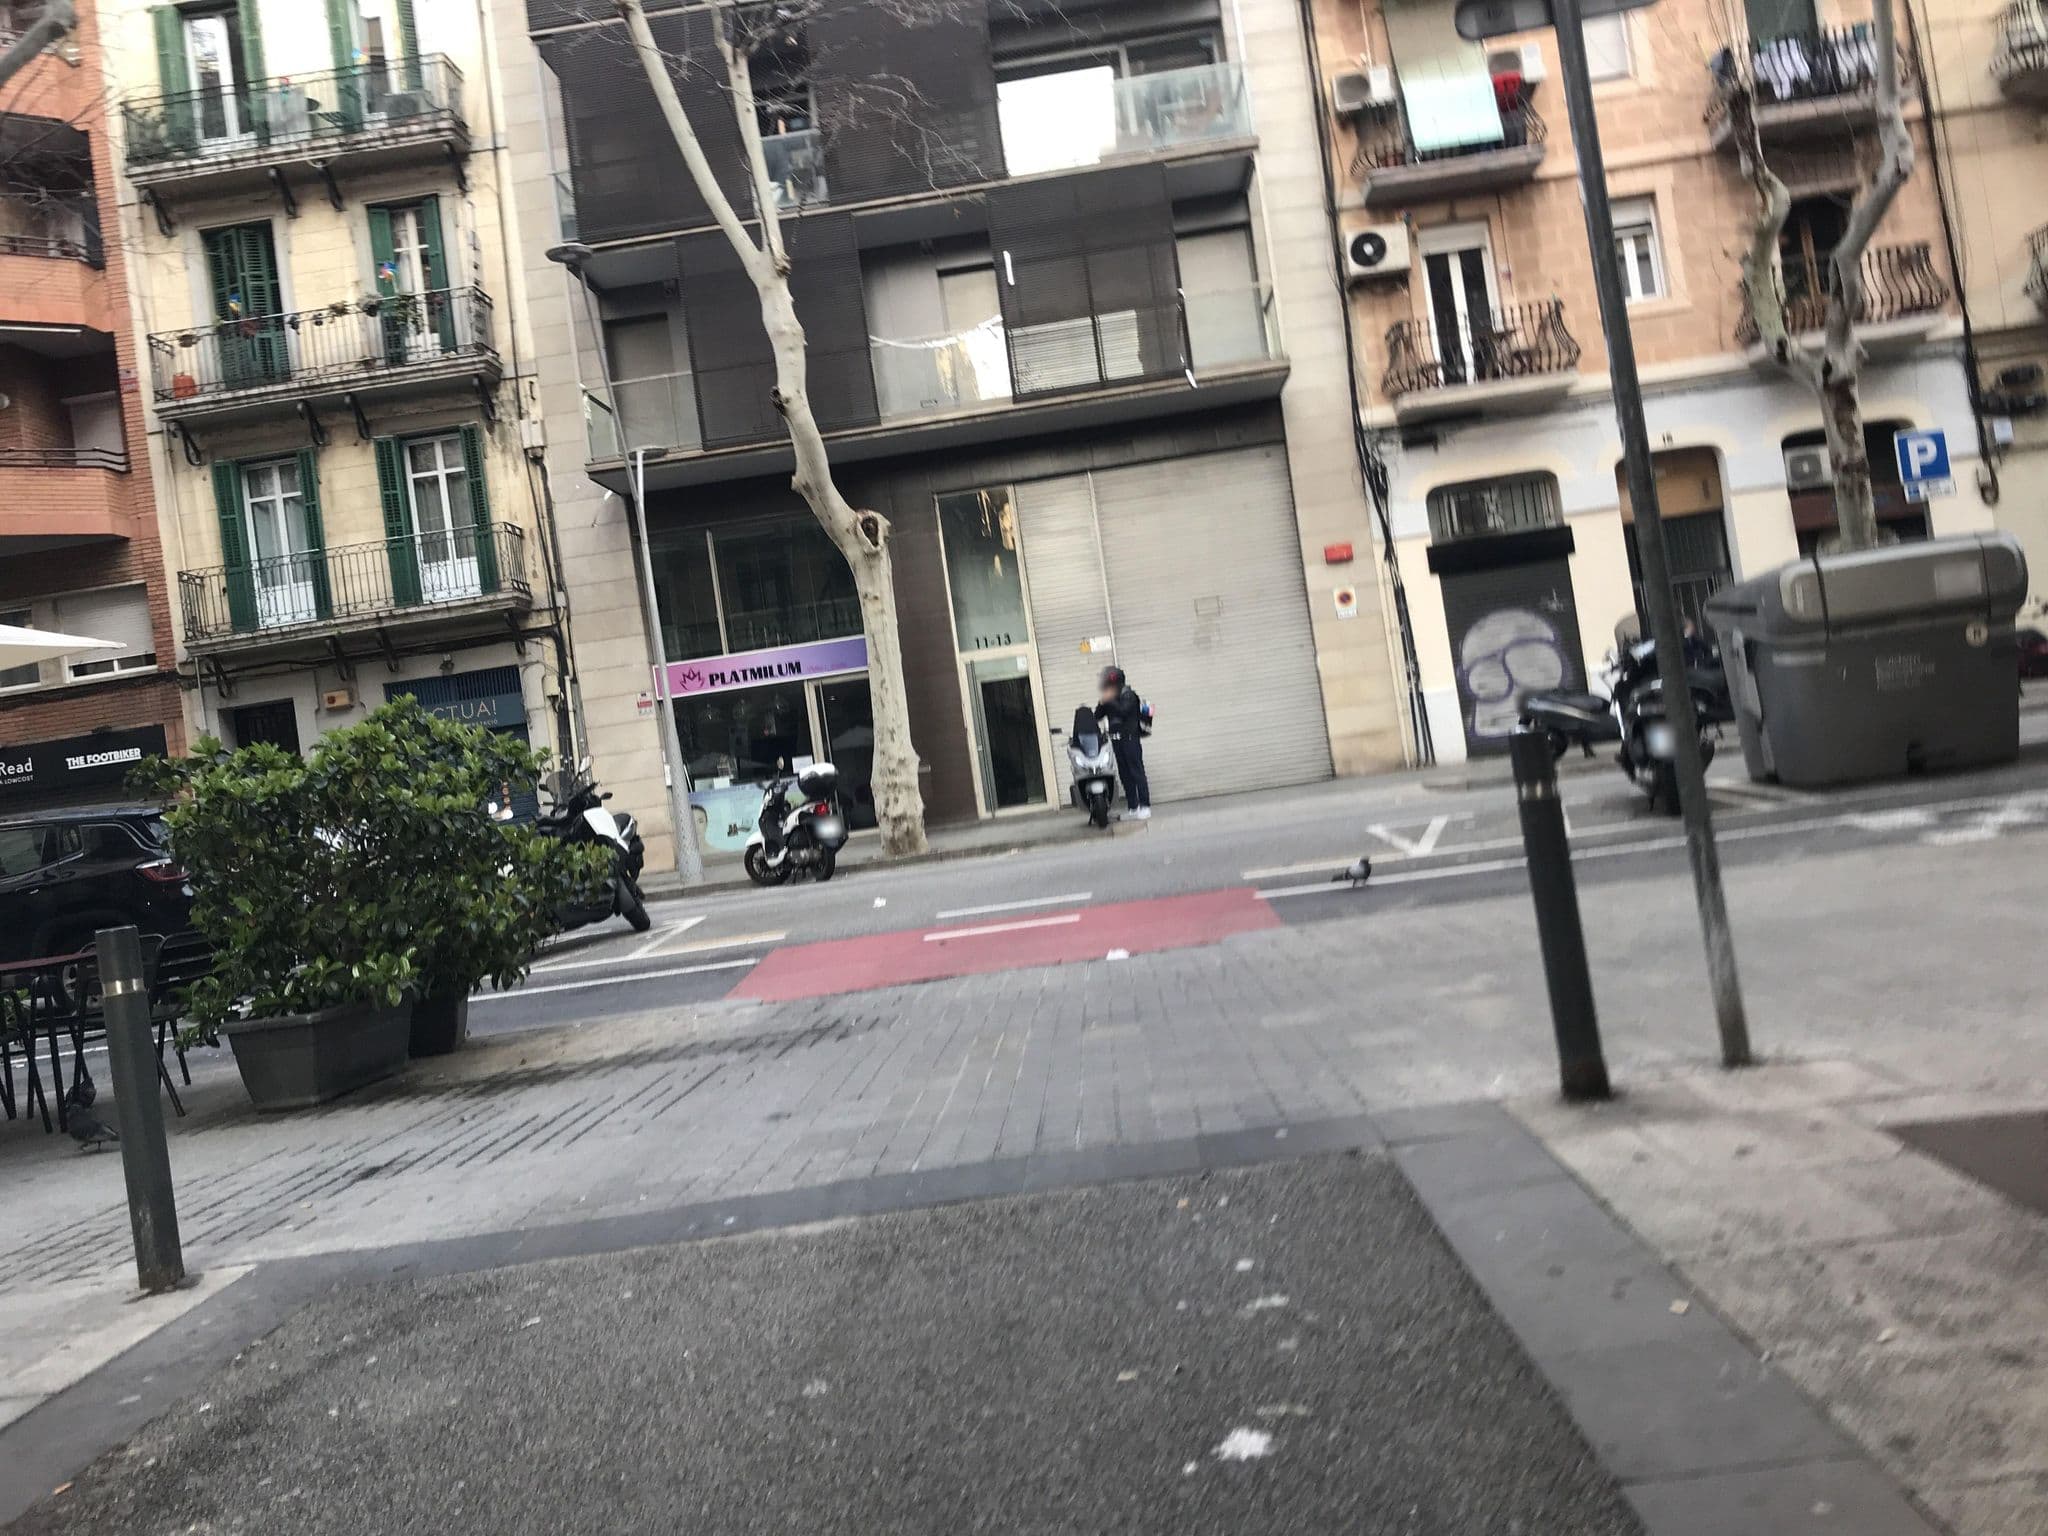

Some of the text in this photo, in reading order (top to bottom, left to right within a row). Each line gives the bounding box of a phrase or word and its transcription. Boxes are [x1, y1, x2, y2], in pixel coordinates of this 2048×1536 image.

[1907, 437, 1937, 481] P
[708, 661, 802, 686] PLATMILUM
[66, 748, 141, 767] THE FOOTBIKER
[4, 775, 34, 785] LOWCOST
